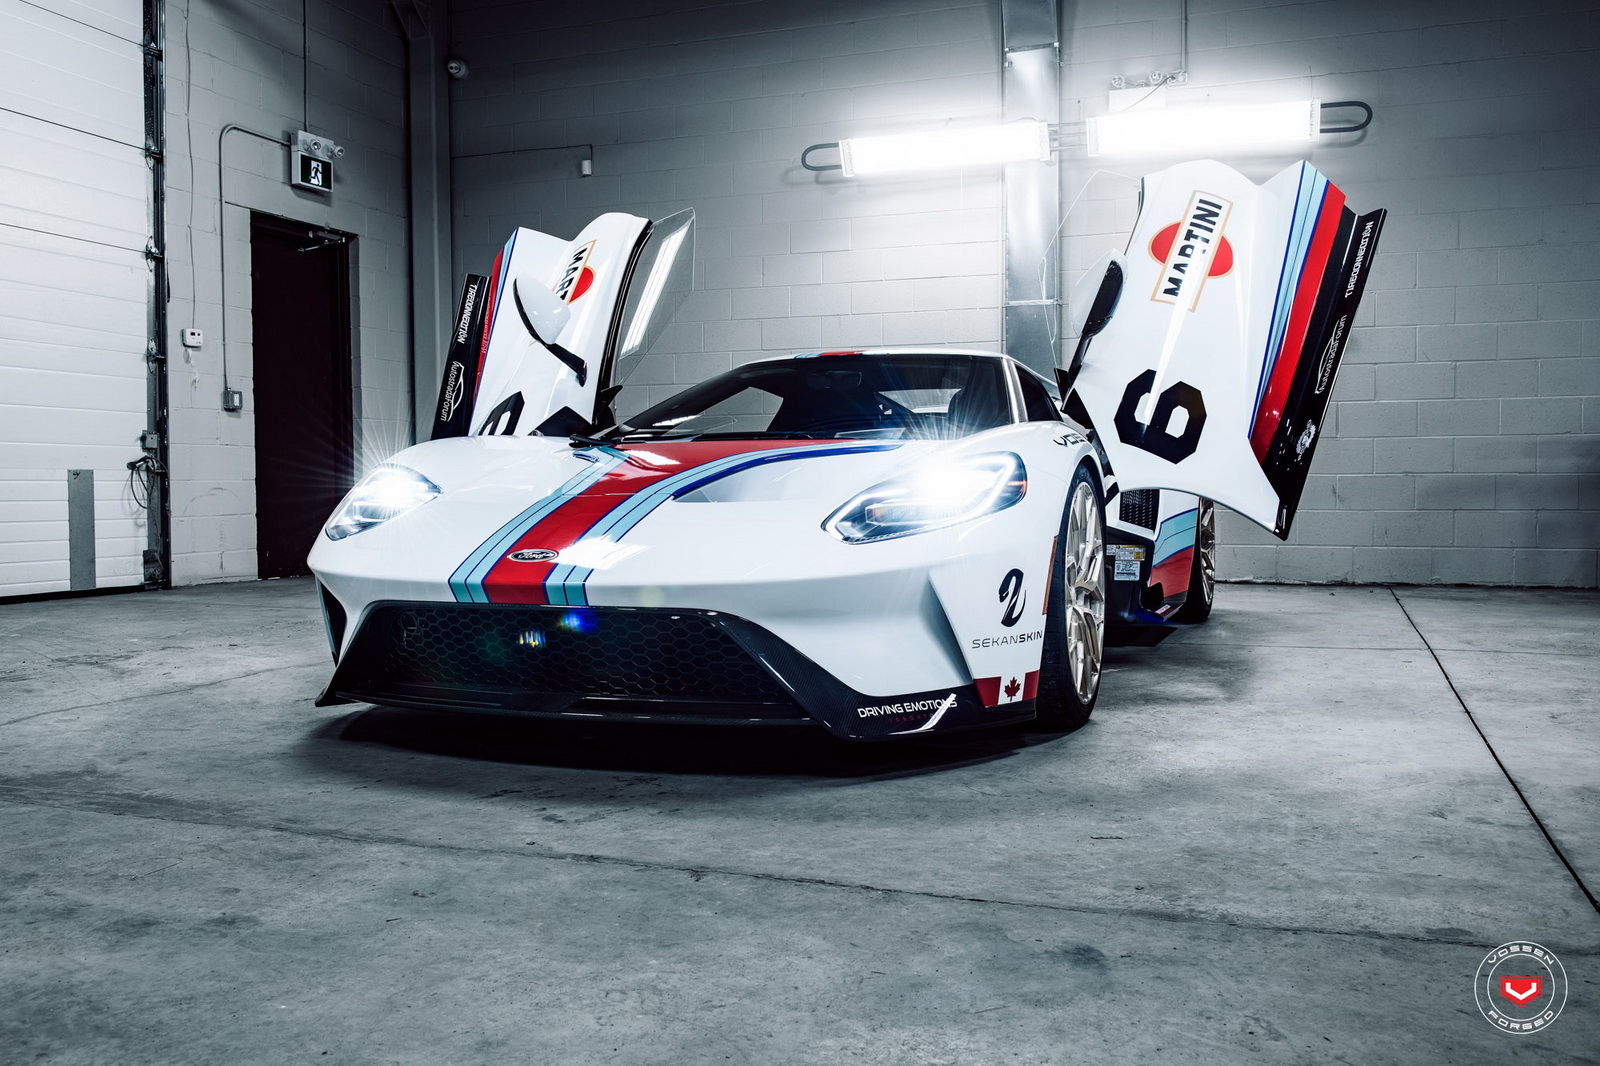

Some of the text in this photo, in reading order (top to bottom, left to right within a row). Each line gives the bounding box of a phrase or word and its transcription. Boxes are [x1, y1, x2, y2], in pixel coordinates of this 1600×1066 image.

[555, 247, 588, 301] MART
[1113, 368, 1208, 465] 6
[518, 551, 554, 559] Ford
[971, 629, 1043, 649] SEKANSKIN
[857, 703, 904, 718] DRIVING
